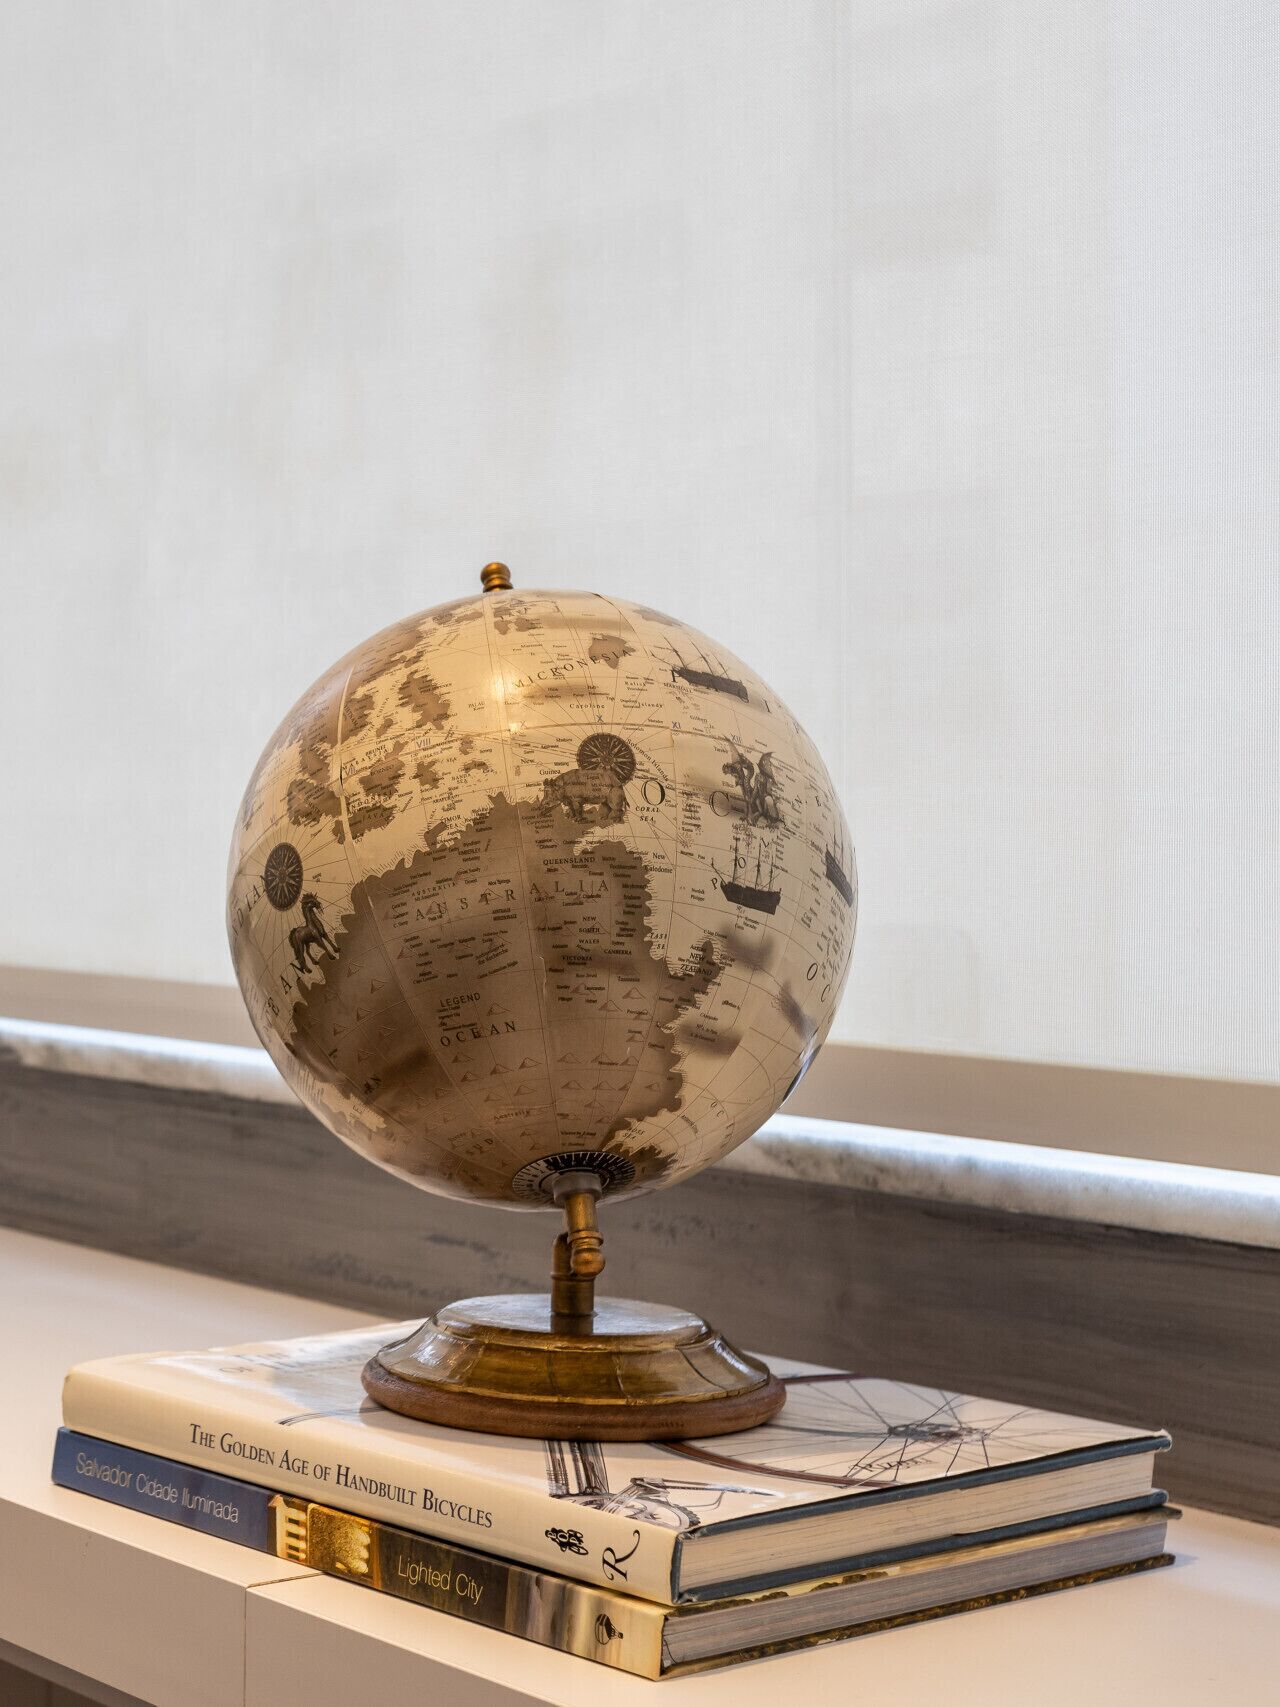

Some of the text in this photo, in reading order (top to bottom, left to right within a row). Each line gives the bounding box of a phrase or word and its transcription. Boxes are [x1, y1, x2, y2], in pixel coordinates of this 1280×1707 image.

[513, 649, 632, 688] MICRONESIA
[416, 737, 431, 748] VIII
[543, 857, 596, 866] QUEENSLAND
[416, 879, 609, 921] AUSTRALIA
[440, 992, 481, 1008] LEGEND
[440, 1020, 517, 1048] OCEAN
[75, 1452, 240, 1525] Salvador Cidade Iluminada
[189, 1423, 494, 1529] THE GOLDEN AGE OF HANDBUILT BICYCLES
[397, 1555, 485, 1605] Lighted City
